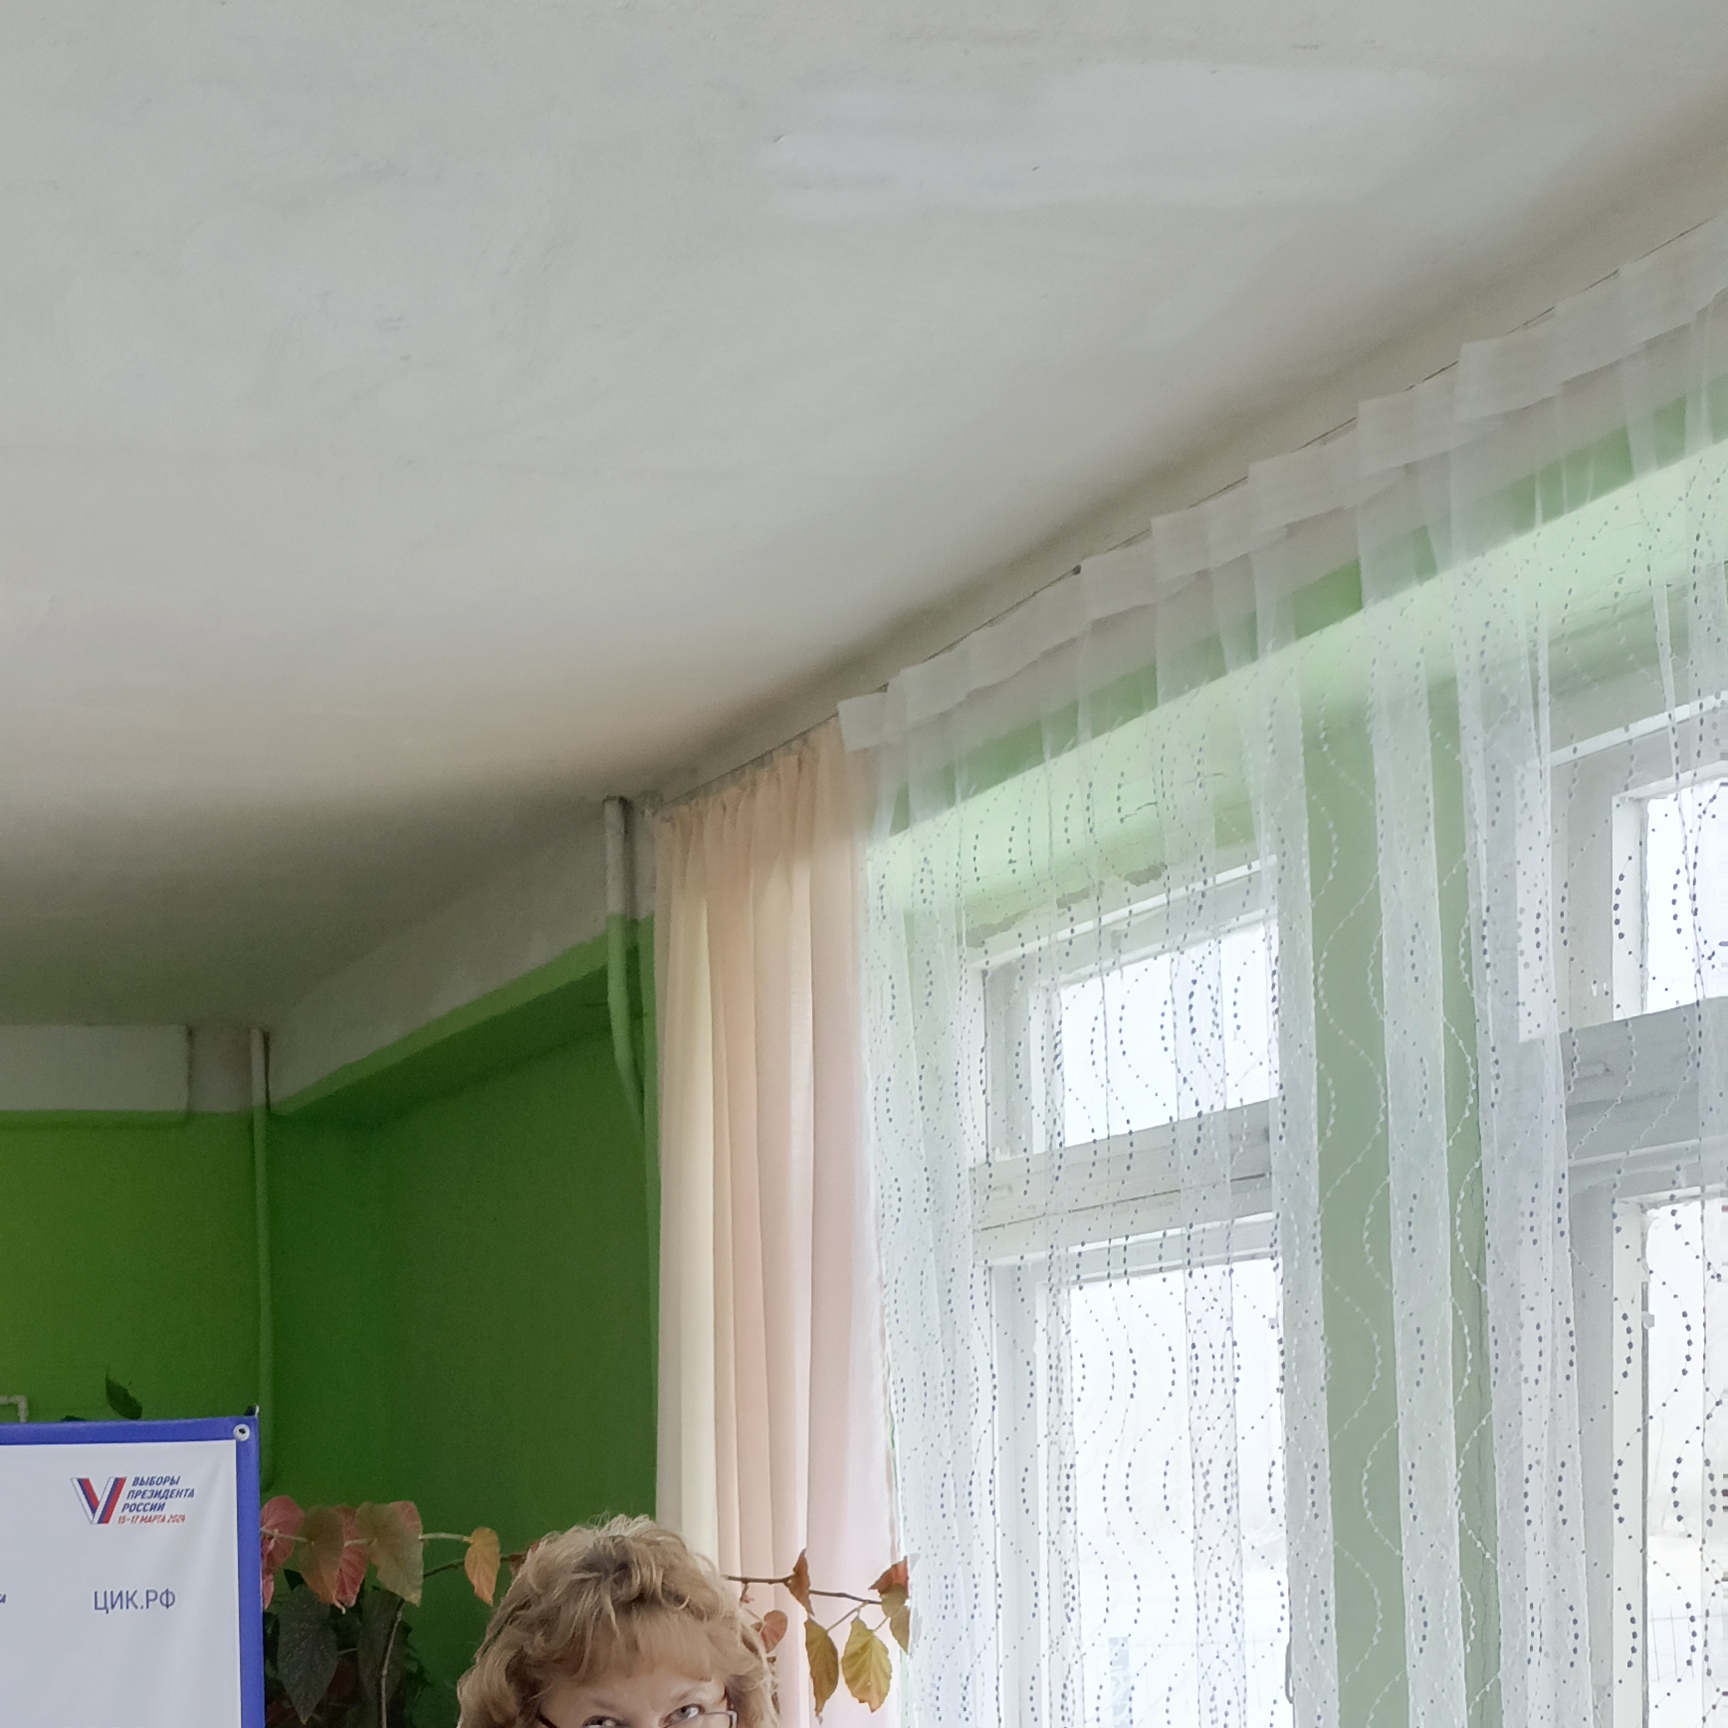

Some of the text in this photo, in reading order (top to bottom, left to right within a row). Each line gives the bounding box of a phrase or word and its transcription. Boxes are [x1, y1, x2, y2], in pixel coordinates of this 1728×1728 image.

[131, 1475, 181, 1487] ВЫБОРЫ
[126, 1488, 195, 1502] ПРЕЗИДЕНТА
[121, 1501, 166, 1513] РОССИИ
[138, 1514, 165, 1524] МАРТА
[168, 1514, 186, 1524] 2024
[94, 1589, 175, 1614] ЦИК.РФ
